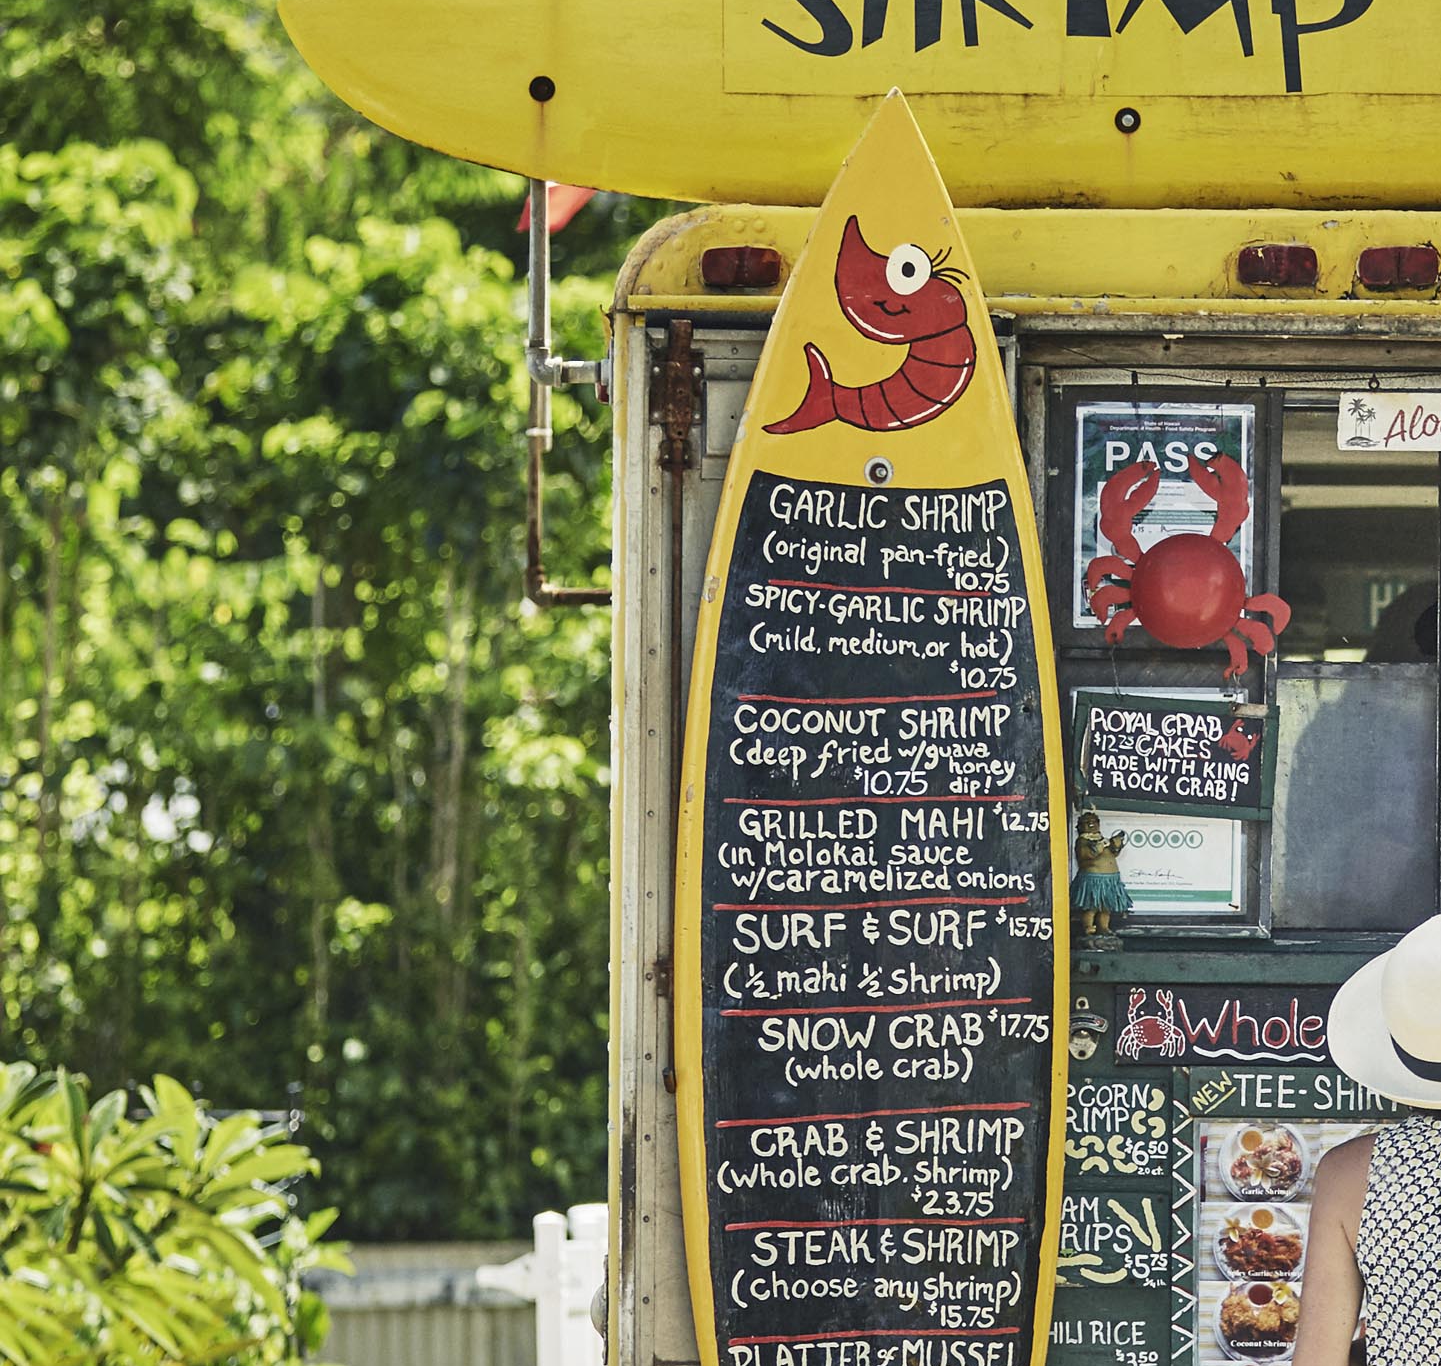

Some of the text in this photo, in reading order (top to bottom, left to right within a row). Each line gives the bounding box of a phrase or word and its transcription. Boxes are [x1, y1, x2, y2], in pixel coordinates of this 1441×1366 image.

[769, 484, 1007, 533] GARLIC SHRIMP
[762, 531, 1008, 580] (original pan-fried)
[947, 567, 1010, 593] $10.75
[745, 584, 1026, 629] SPICY-GARLIC SHRIMP
[749, 623, 821, 654] (mild,
[961, 630, 1013, 666] hot)
[949, 660, 1016, 690] $10.75
[733, 705, 1011, 739] COCONUT SHRIMP
[1091, 707, 1223, 742] ROYAL CRAB
[730, 738, 990, 781] (deep fried w/guava
[1135, 735, 1211, 759] CAKES
[854, 756, 1015, 796] $10.75 honey
[950, 776, 991, 797] dip!
[1093, 754, 1250, 785] MADE WITH KING
[1093, 770, 1238, 802] & ROCK CRAB!
[739, 802, 1049, 842] GRILLED MAHI $12.75
[718, 841, 972, 869] (in Molokai sauce
[731, 865, 1035, 900] w/caramelized onions
[733, 909, 1052, 954] SURF & SURF $15.75
[776, 962, 848, 995] mahi
[758, 1008, 1050, 1052] SNOW CRAB $17.75
[1177, 997, 1327, 1049] Whole
[785, 1046, 973, 1087] (whole crab)
[1191, 1071, 1234, 1110] NEW
[751, 1118, 1025, 1158] CRAB & SHRIMP
[911, 1185, 994, 1217] $23.75
[1265, 1188, 1291, 1196] Shrimp
[751, 1230, 1020, 1267] STEAK & SHRIMP
[732, 1270, 859, 1308] (choose
[873, 1276, 918, 1311] any
[928, 1302, 996, 1328] $15.75
[1089, 1321, 1146, 1345] RICE
[1263, 1340, 1293, 1349] Shrimp
